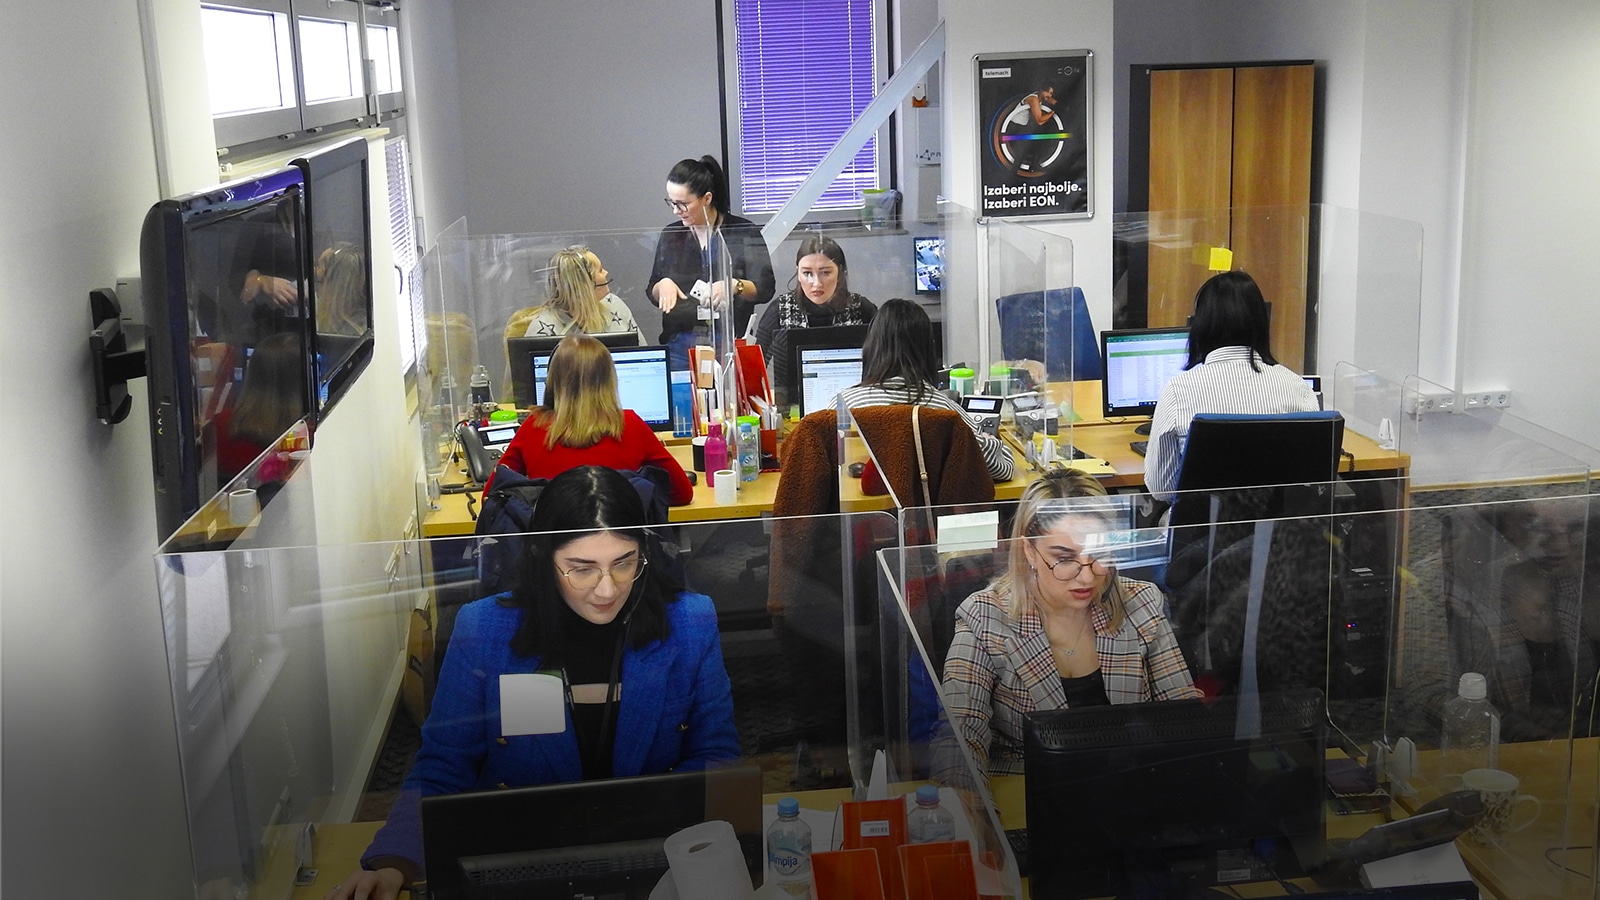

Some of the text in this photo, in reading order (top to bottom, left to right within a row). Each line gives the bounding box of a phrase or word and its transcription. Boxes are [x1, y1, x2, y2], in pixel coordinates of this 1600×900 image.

[984, 181, 1082, 196] Izaberi najbolje.
[984, 195, 1059, 209] Izaberi EON.
